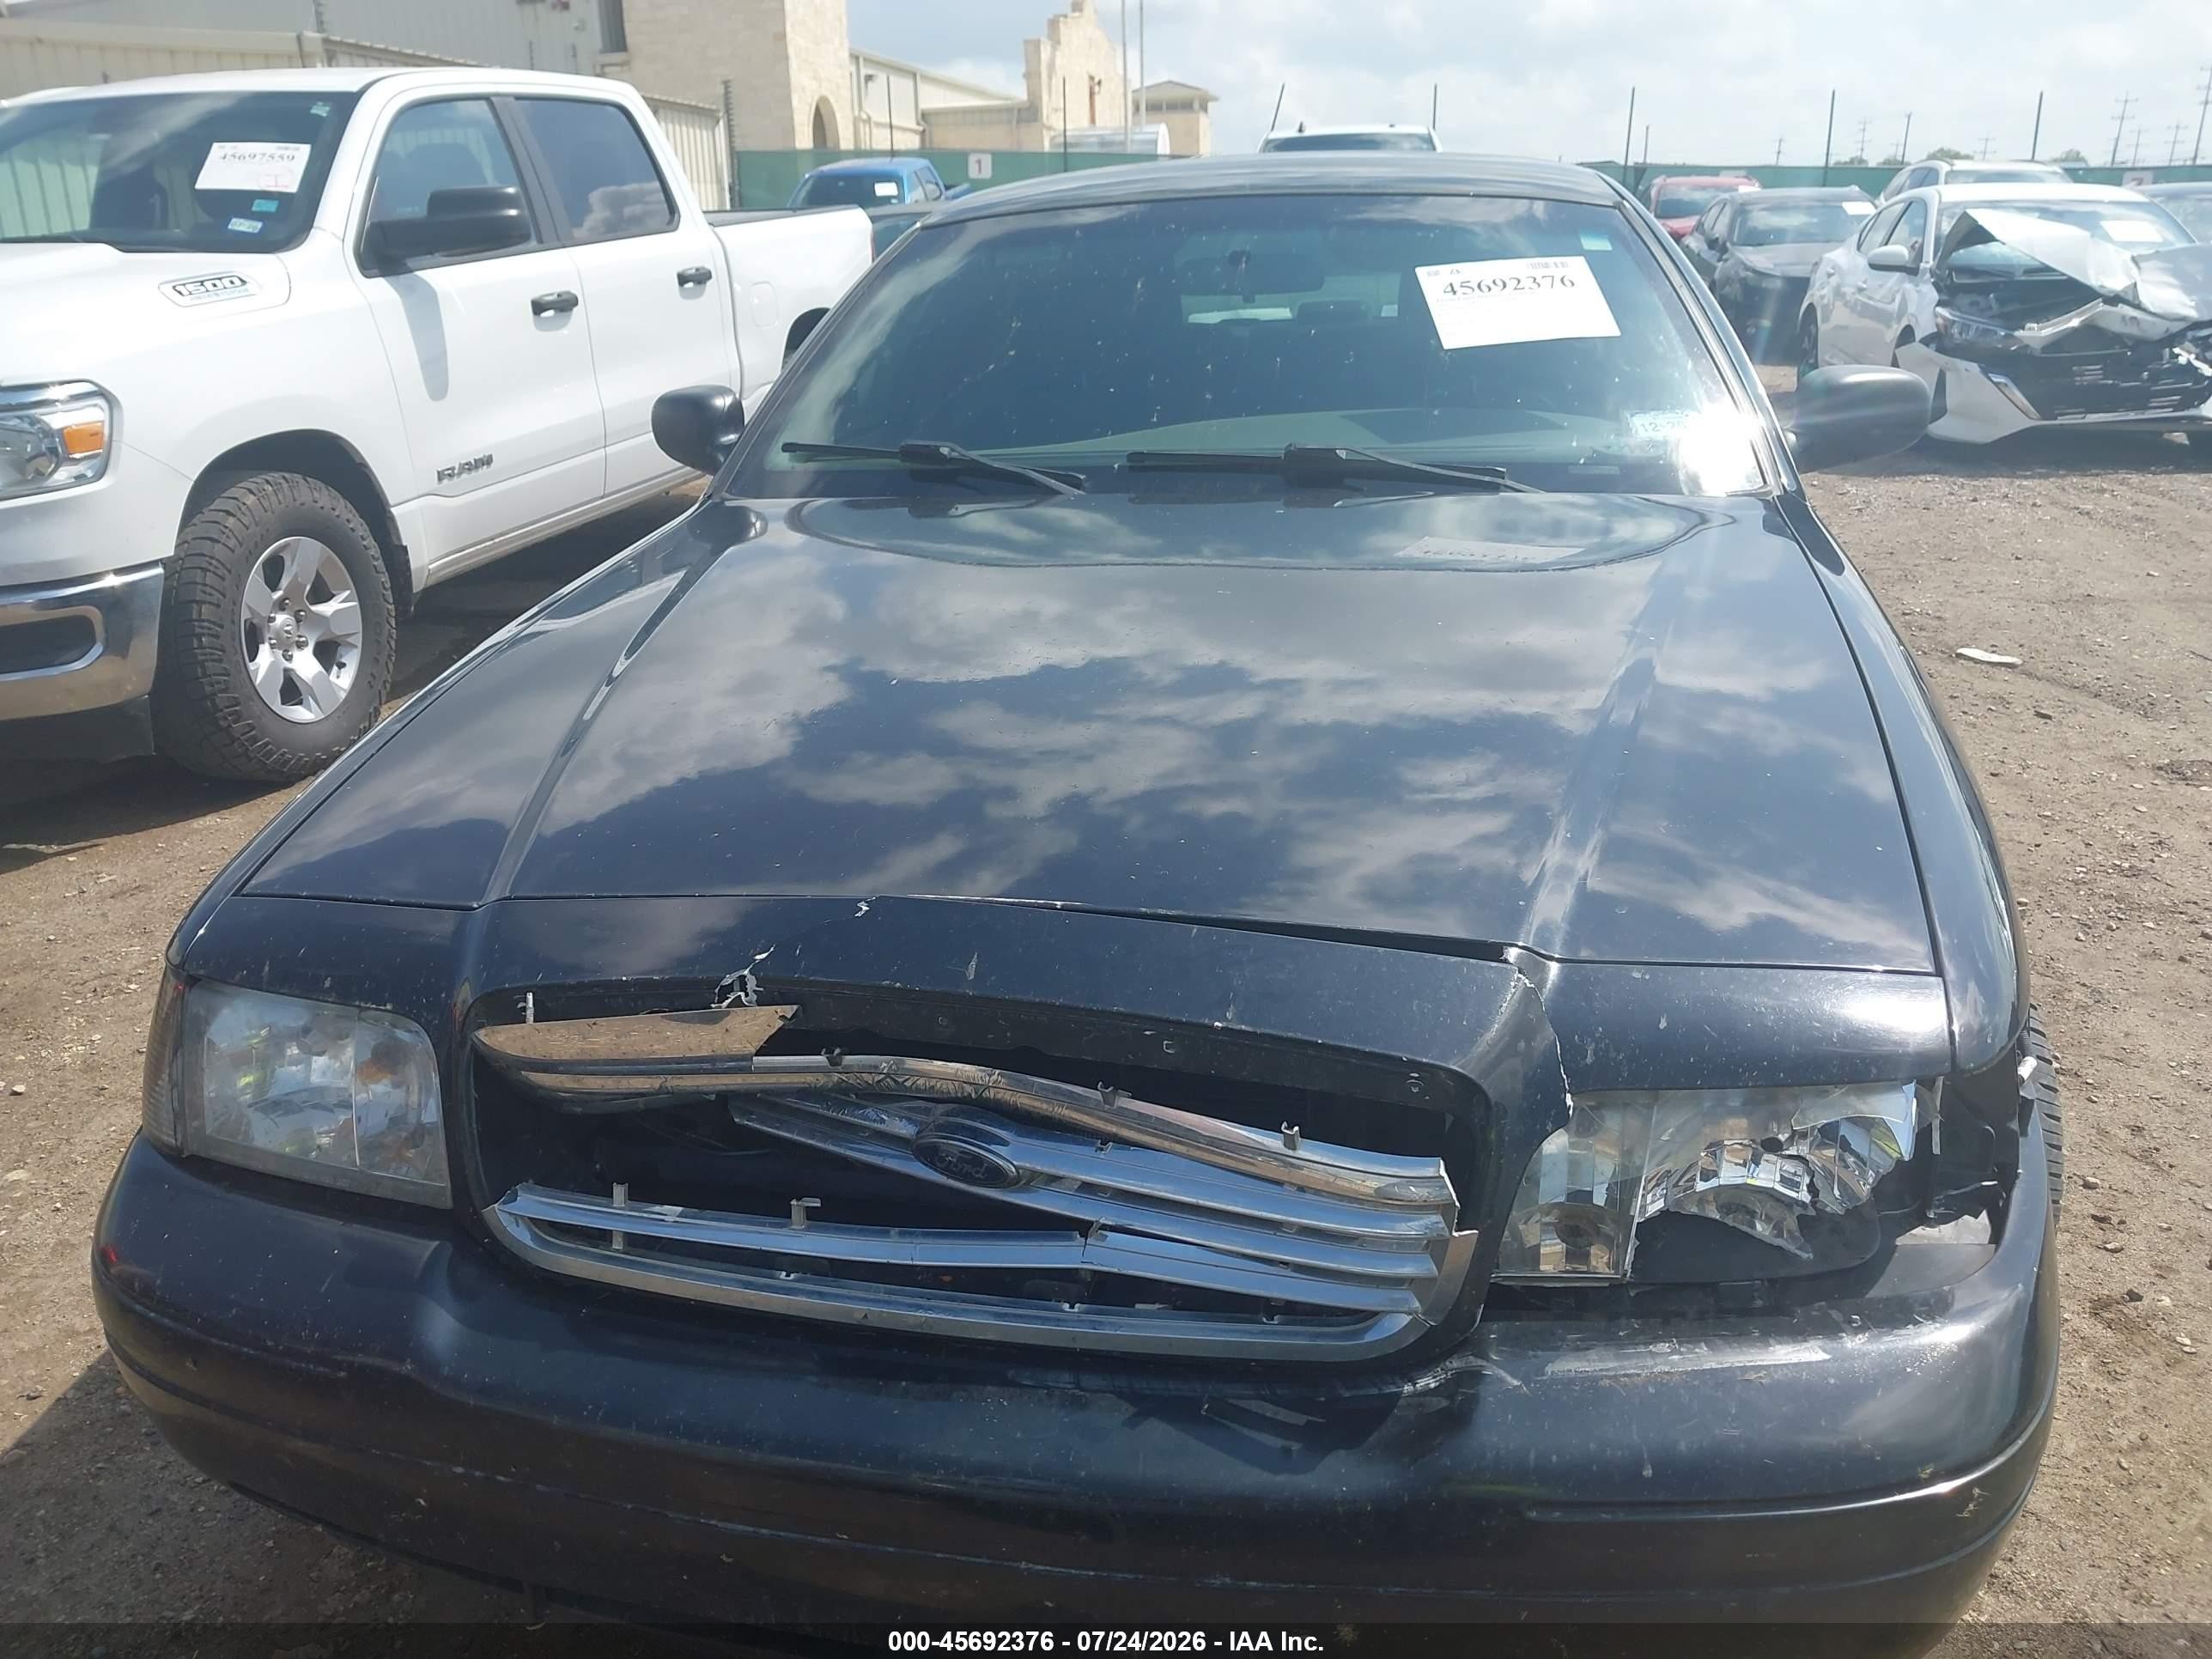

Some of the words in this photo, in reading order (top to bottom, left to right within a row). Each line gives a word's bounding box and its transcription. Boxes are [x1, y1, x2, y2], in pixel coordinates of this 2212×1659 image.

[220, 153, 295, 162] 45697559
[173, 276, 243, 296] 1500
[1443, 274, 1576, 296] 45692376
[436, 453, 494, 484] RAM
[935, 1152, 988, 1179] Ford
